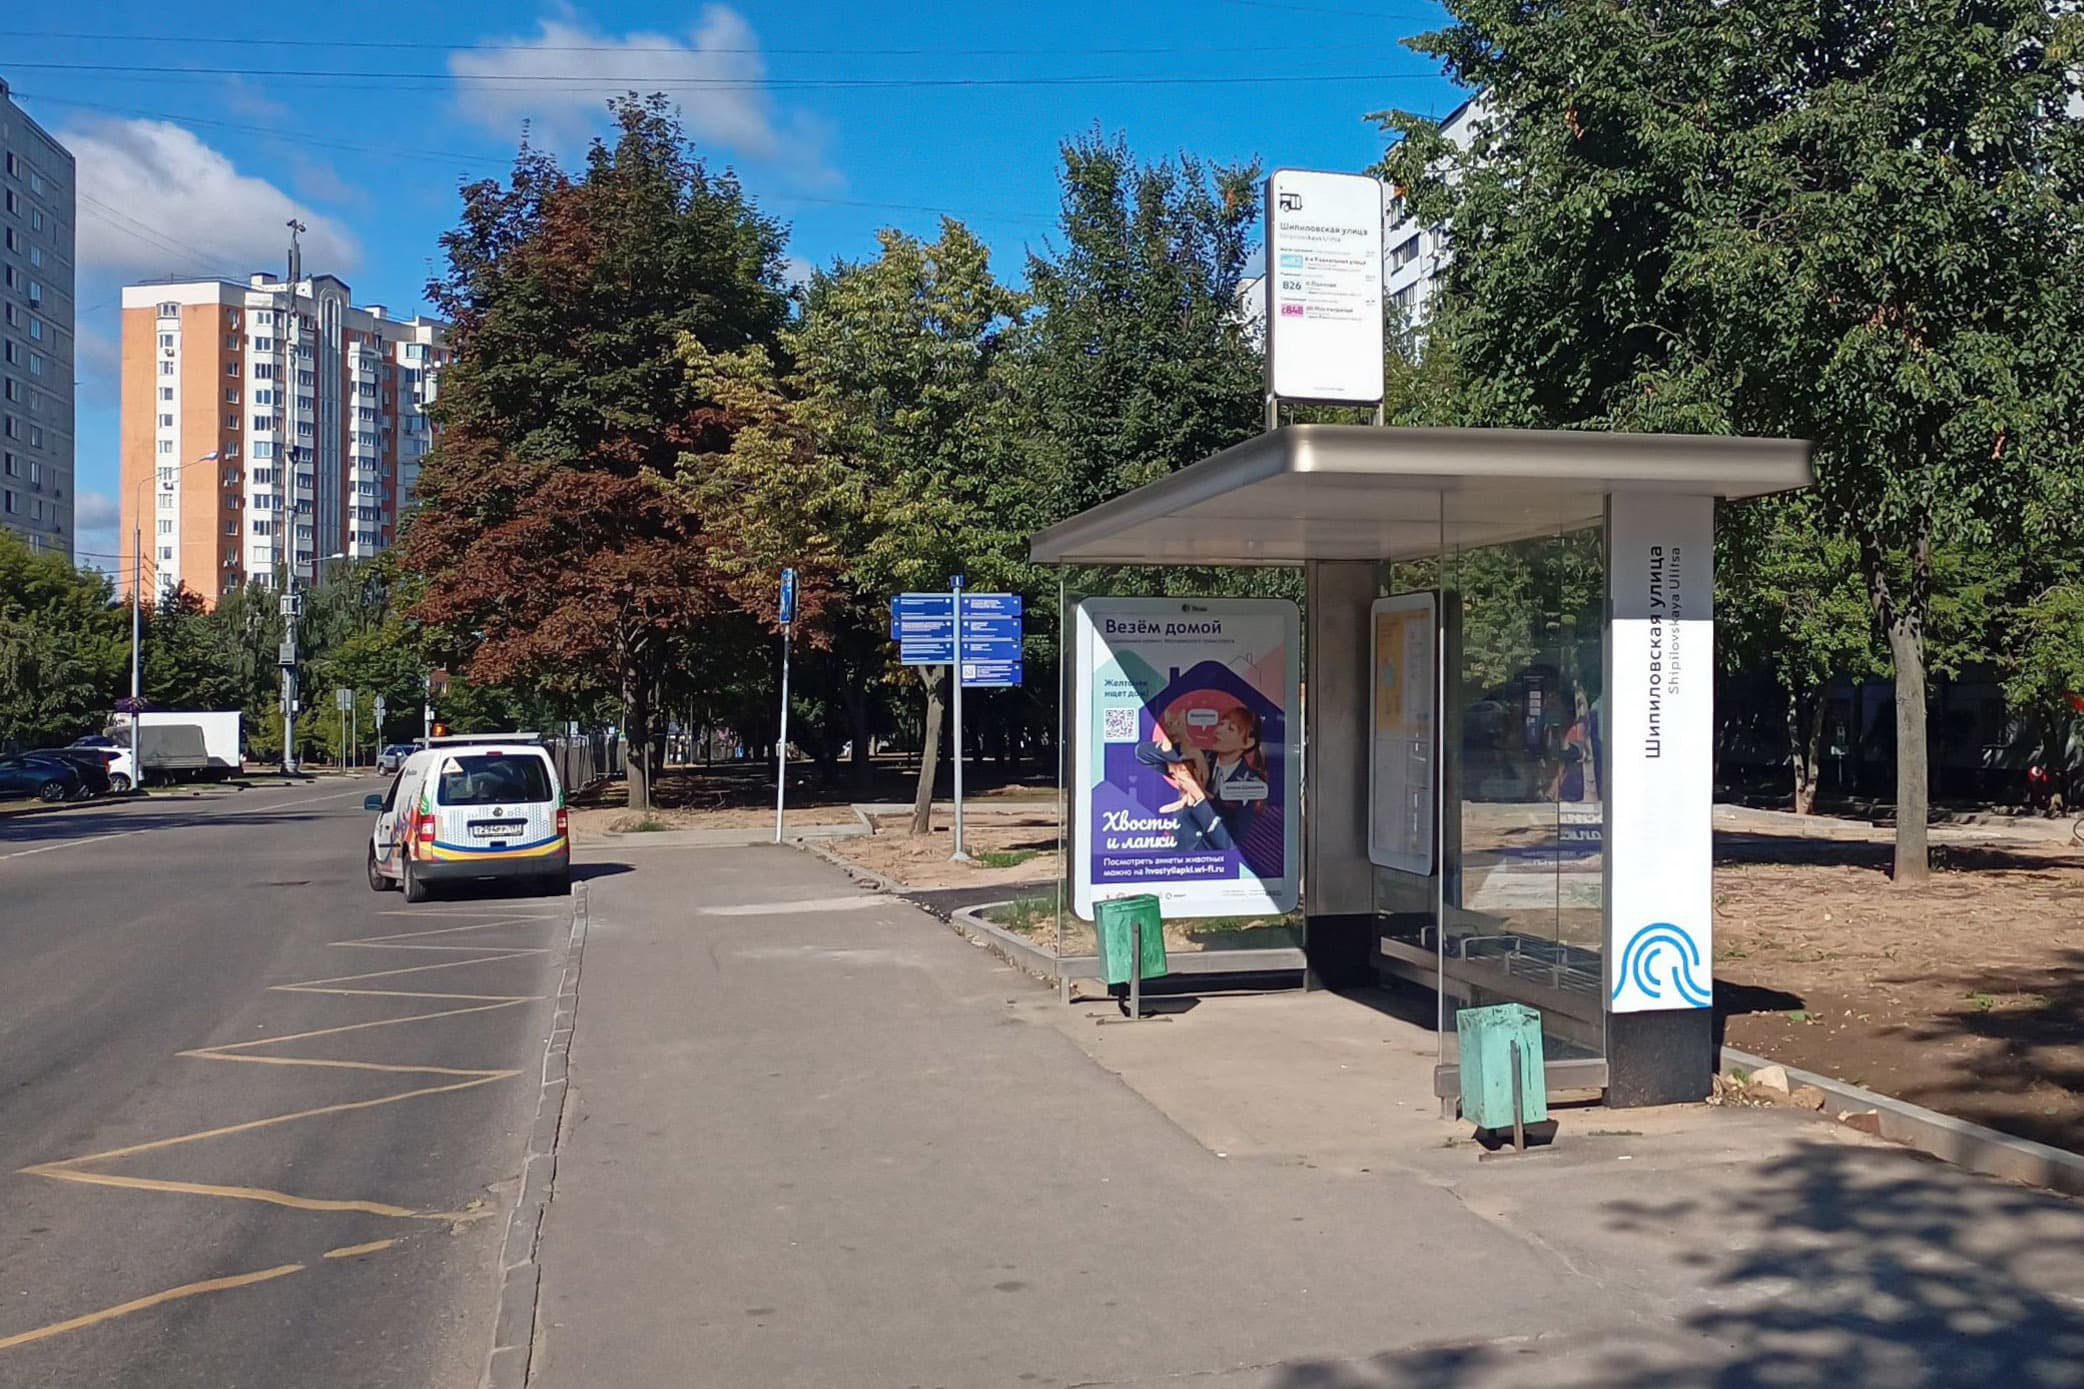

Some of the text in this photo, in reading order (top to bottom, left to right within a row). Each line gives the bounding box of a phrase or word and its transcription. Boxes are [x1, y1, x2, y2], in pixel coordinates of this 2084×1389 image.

[1280, 222, 1368, 236] Шипиловская улица
[1105, 619, 1222, 636] Везём домой
[1668, 547, 1682, 694] Shipilovskaya Ulitsa
[1646, 545, 1665, 758] Шипиловская улица
[1102, 810, 1181, 832] Хвосты
[1106, 836, 1178, 849] и лапки
[1103, 857, 1153, 867] Посмотреть
